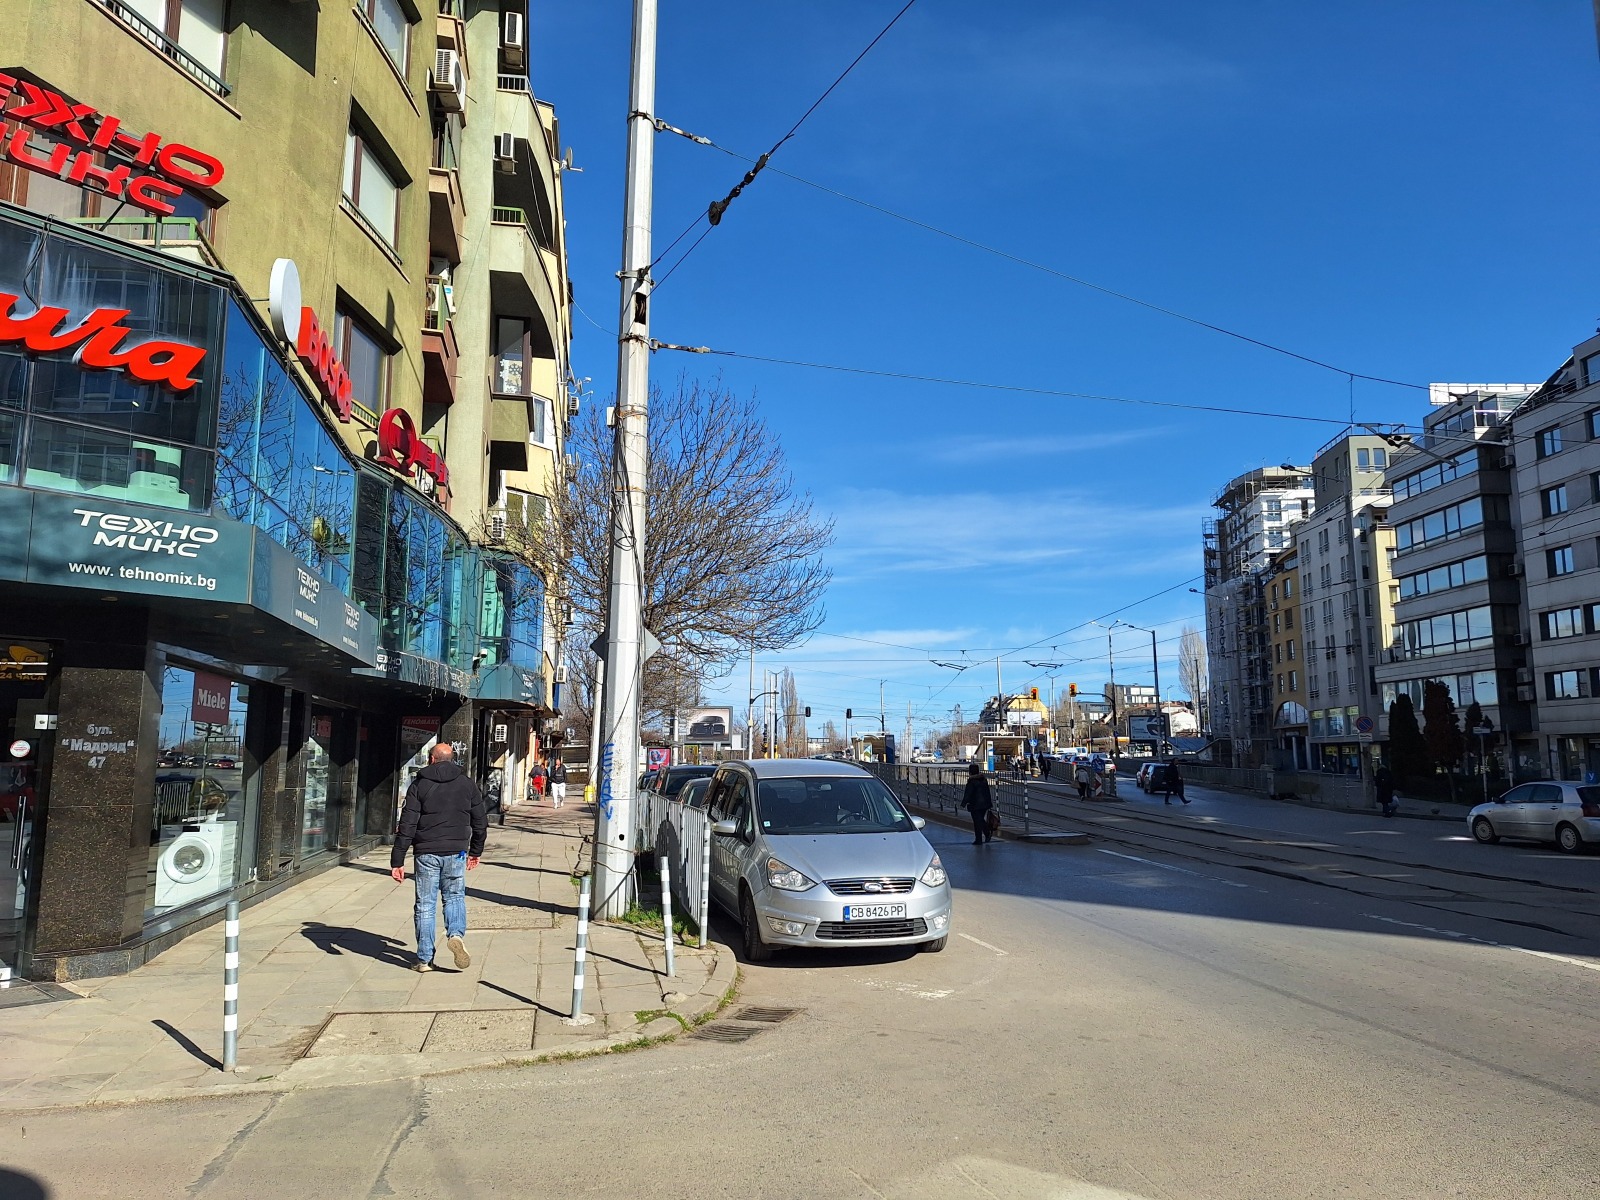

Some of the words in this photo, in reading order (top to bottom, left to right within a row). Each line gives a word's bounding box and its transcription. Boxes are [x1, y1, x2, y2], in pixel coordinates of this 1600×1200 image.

[73, 508, 219, 544] ТЕХНО
[68, 562, 114, 577] www.
[119, 565, 217, 591] tehnomix.bg
[197, 688, 227, 710] Miele
[87, 723, 113, 737] бул.
[87, 756, 107, 769] 47
[851, 908, 864, 918] CB
[866, 907, 889, 917] 8426
[891, 906, 903, 916] PP
